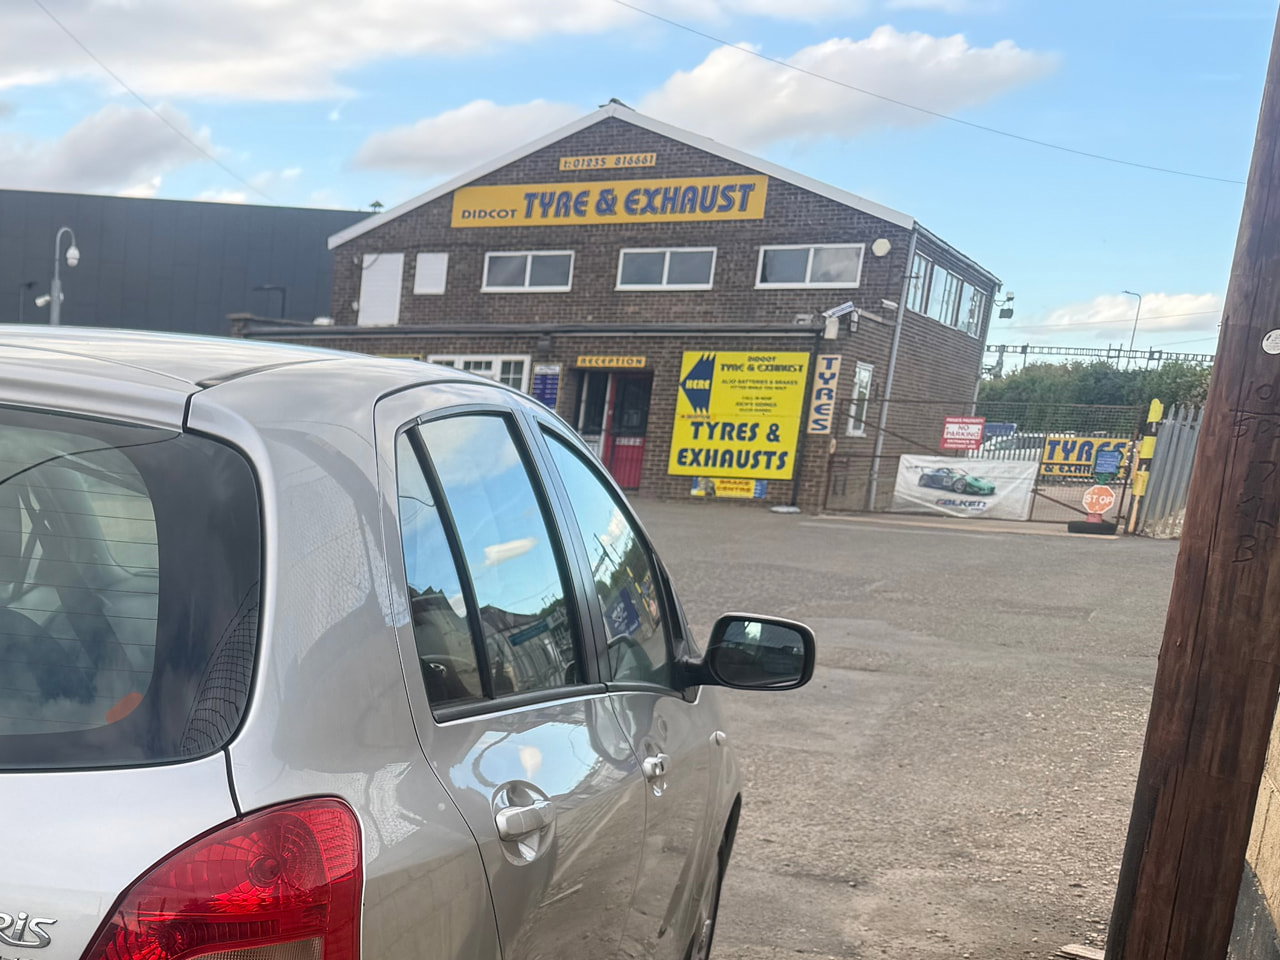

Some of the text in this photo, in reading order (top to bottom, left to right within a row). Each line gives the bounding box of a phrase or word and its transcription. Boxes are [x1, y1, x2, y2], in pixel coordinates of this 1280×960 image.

[613, 153, 654, 167] 816661
[461, 182, 756, 219] DIDCOT TYRE & EXHAUST
[580, 357, 643, 366] RECEPTION
[686, 379, 710, 390] HERE
[810, 357, 839, 432] TYRES
[691, 421, 780, 442] TYRES &
[677, 448, 788, 470] EXHAUSTS
[1084, 494, 1113, 504] STOP
